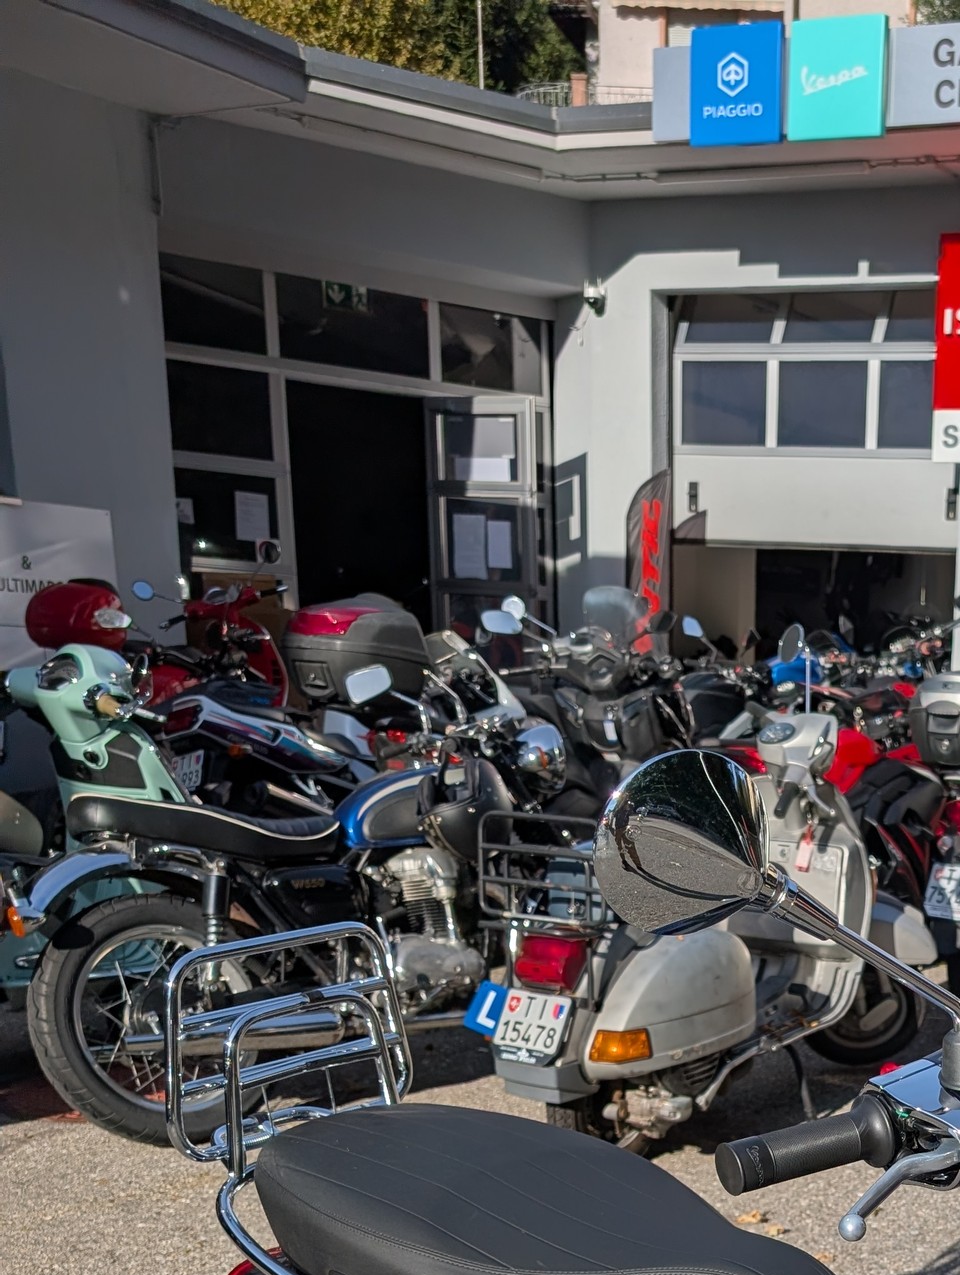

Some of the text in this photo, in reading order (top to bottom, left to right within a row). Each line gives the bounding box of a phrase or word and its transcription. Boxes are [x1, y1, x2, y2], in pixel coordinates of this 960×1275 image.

[801, 65, 869, 96] Vespa
[702, 103, 763, 119] PIAGGIO
[21, 555, 32, 570] &
[476, 990, 497, 1029] L
[525, 996, 548, 1020] TI
[500, 1020, 556, 1049] 15478
